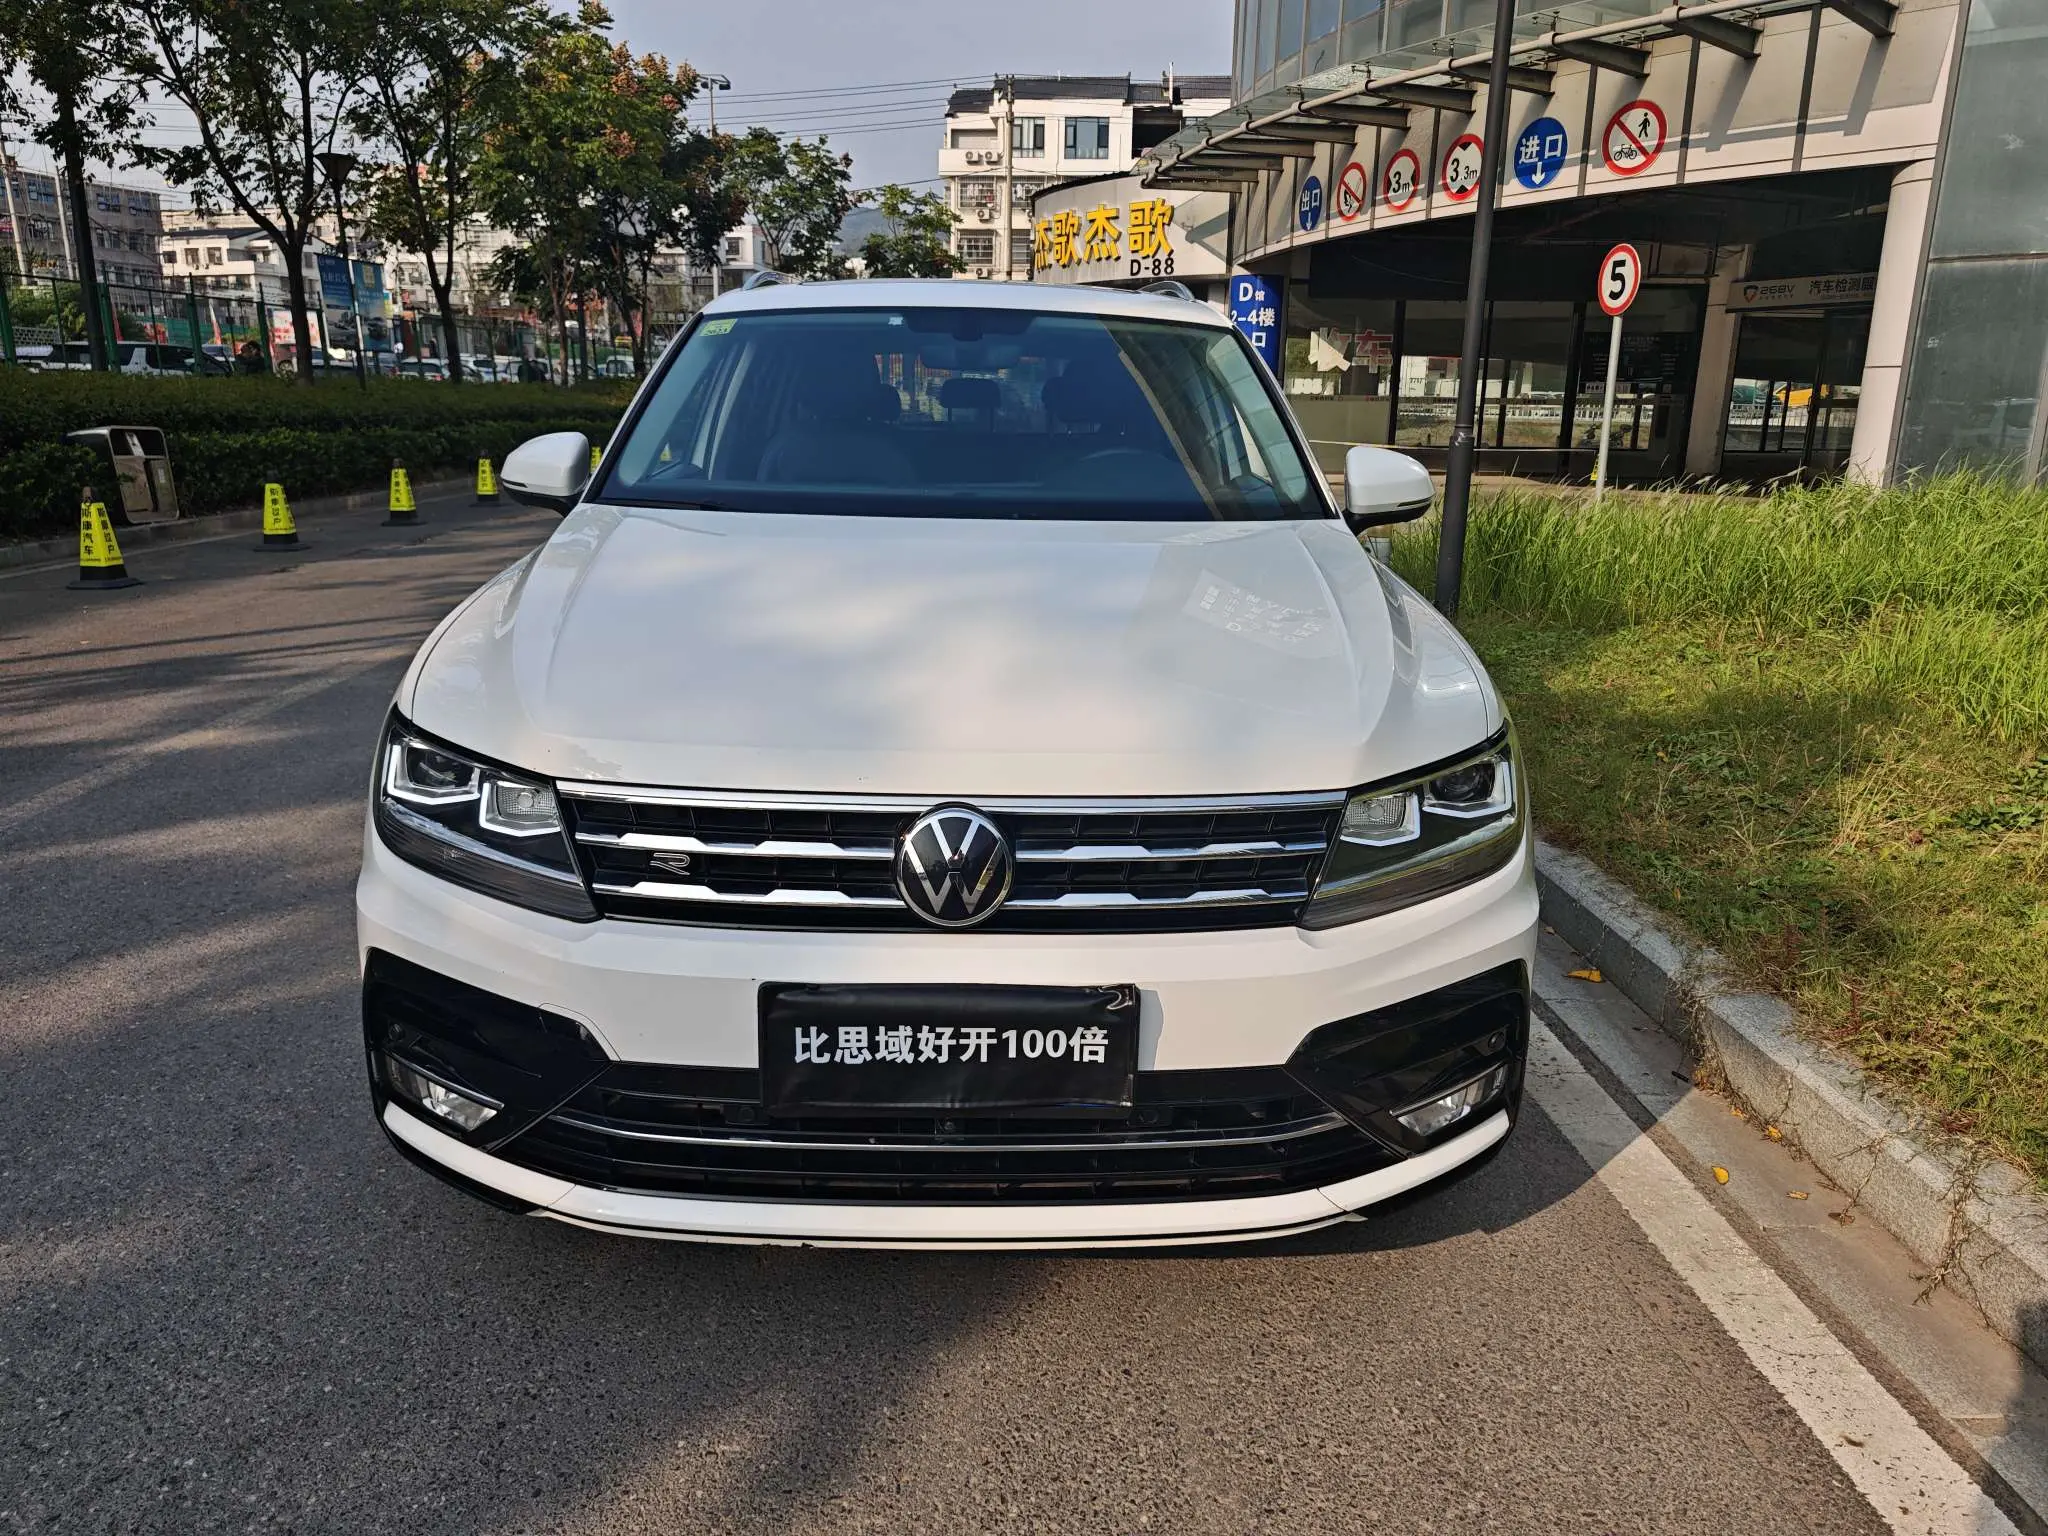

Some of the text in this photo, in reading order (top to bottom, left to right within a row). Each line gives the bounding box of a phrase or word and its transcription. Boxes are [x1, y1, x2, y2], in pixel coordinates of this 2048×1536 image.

[1519, 134, 1563, 164] 进口
[1450, 157, 1478, 182] 3.3m
[1392, 171, 1410, 194] 3m
[1301, 188, 1320, 212] 出口
[1034, 197, 1174, 271] 杰歌杰歌
[1130, 257, 1174, 276] D-88
[1608, 259, 1626, 300] 5
[1231, 307, 1275, 327] 2-4楼
[794, 1025, 1109, 1065] 比思域好开100倍
